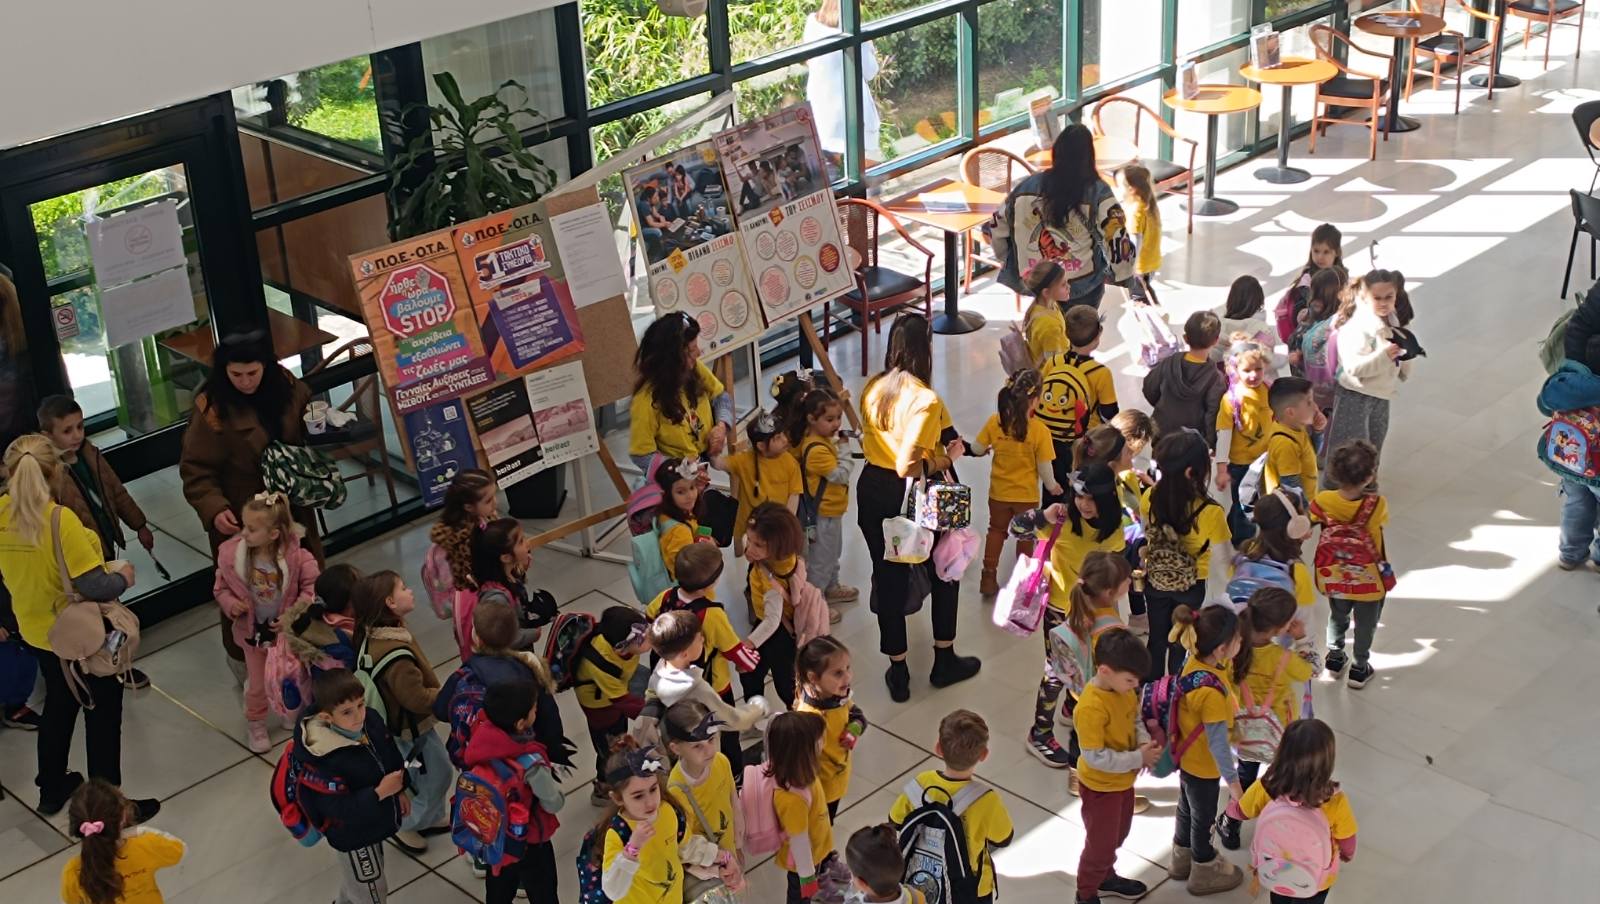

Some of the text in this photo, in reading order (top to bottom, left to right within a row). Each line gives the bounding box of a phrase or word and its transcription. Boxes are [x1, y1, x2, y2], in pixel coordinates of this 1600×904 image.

[799, 193, 824, 211] ΣΕΙΣΜΟΥ
[499, 244, 530, 262] ΤΑΚΤΙΚΟ
[688, 236, 734, 261] ΠΙΘΑΝΟ ΣΕΙΣΜΟ
[389, 277, 416, 294] ήρθε
[396, 293, 441, 314] βάλουμε
[400, 304, 448, 333] STOP
[411, 341, 461, 363] εξαθλιώνει
[402, 355, 468, 378] τις ζωές μας
[395, 381, 432, 400] Γενναίες
[432, 369, 471, 388] Αυξήσεις
[449, 372, 488, 392] ΣΥΝΤΑΞΕΙΣ
